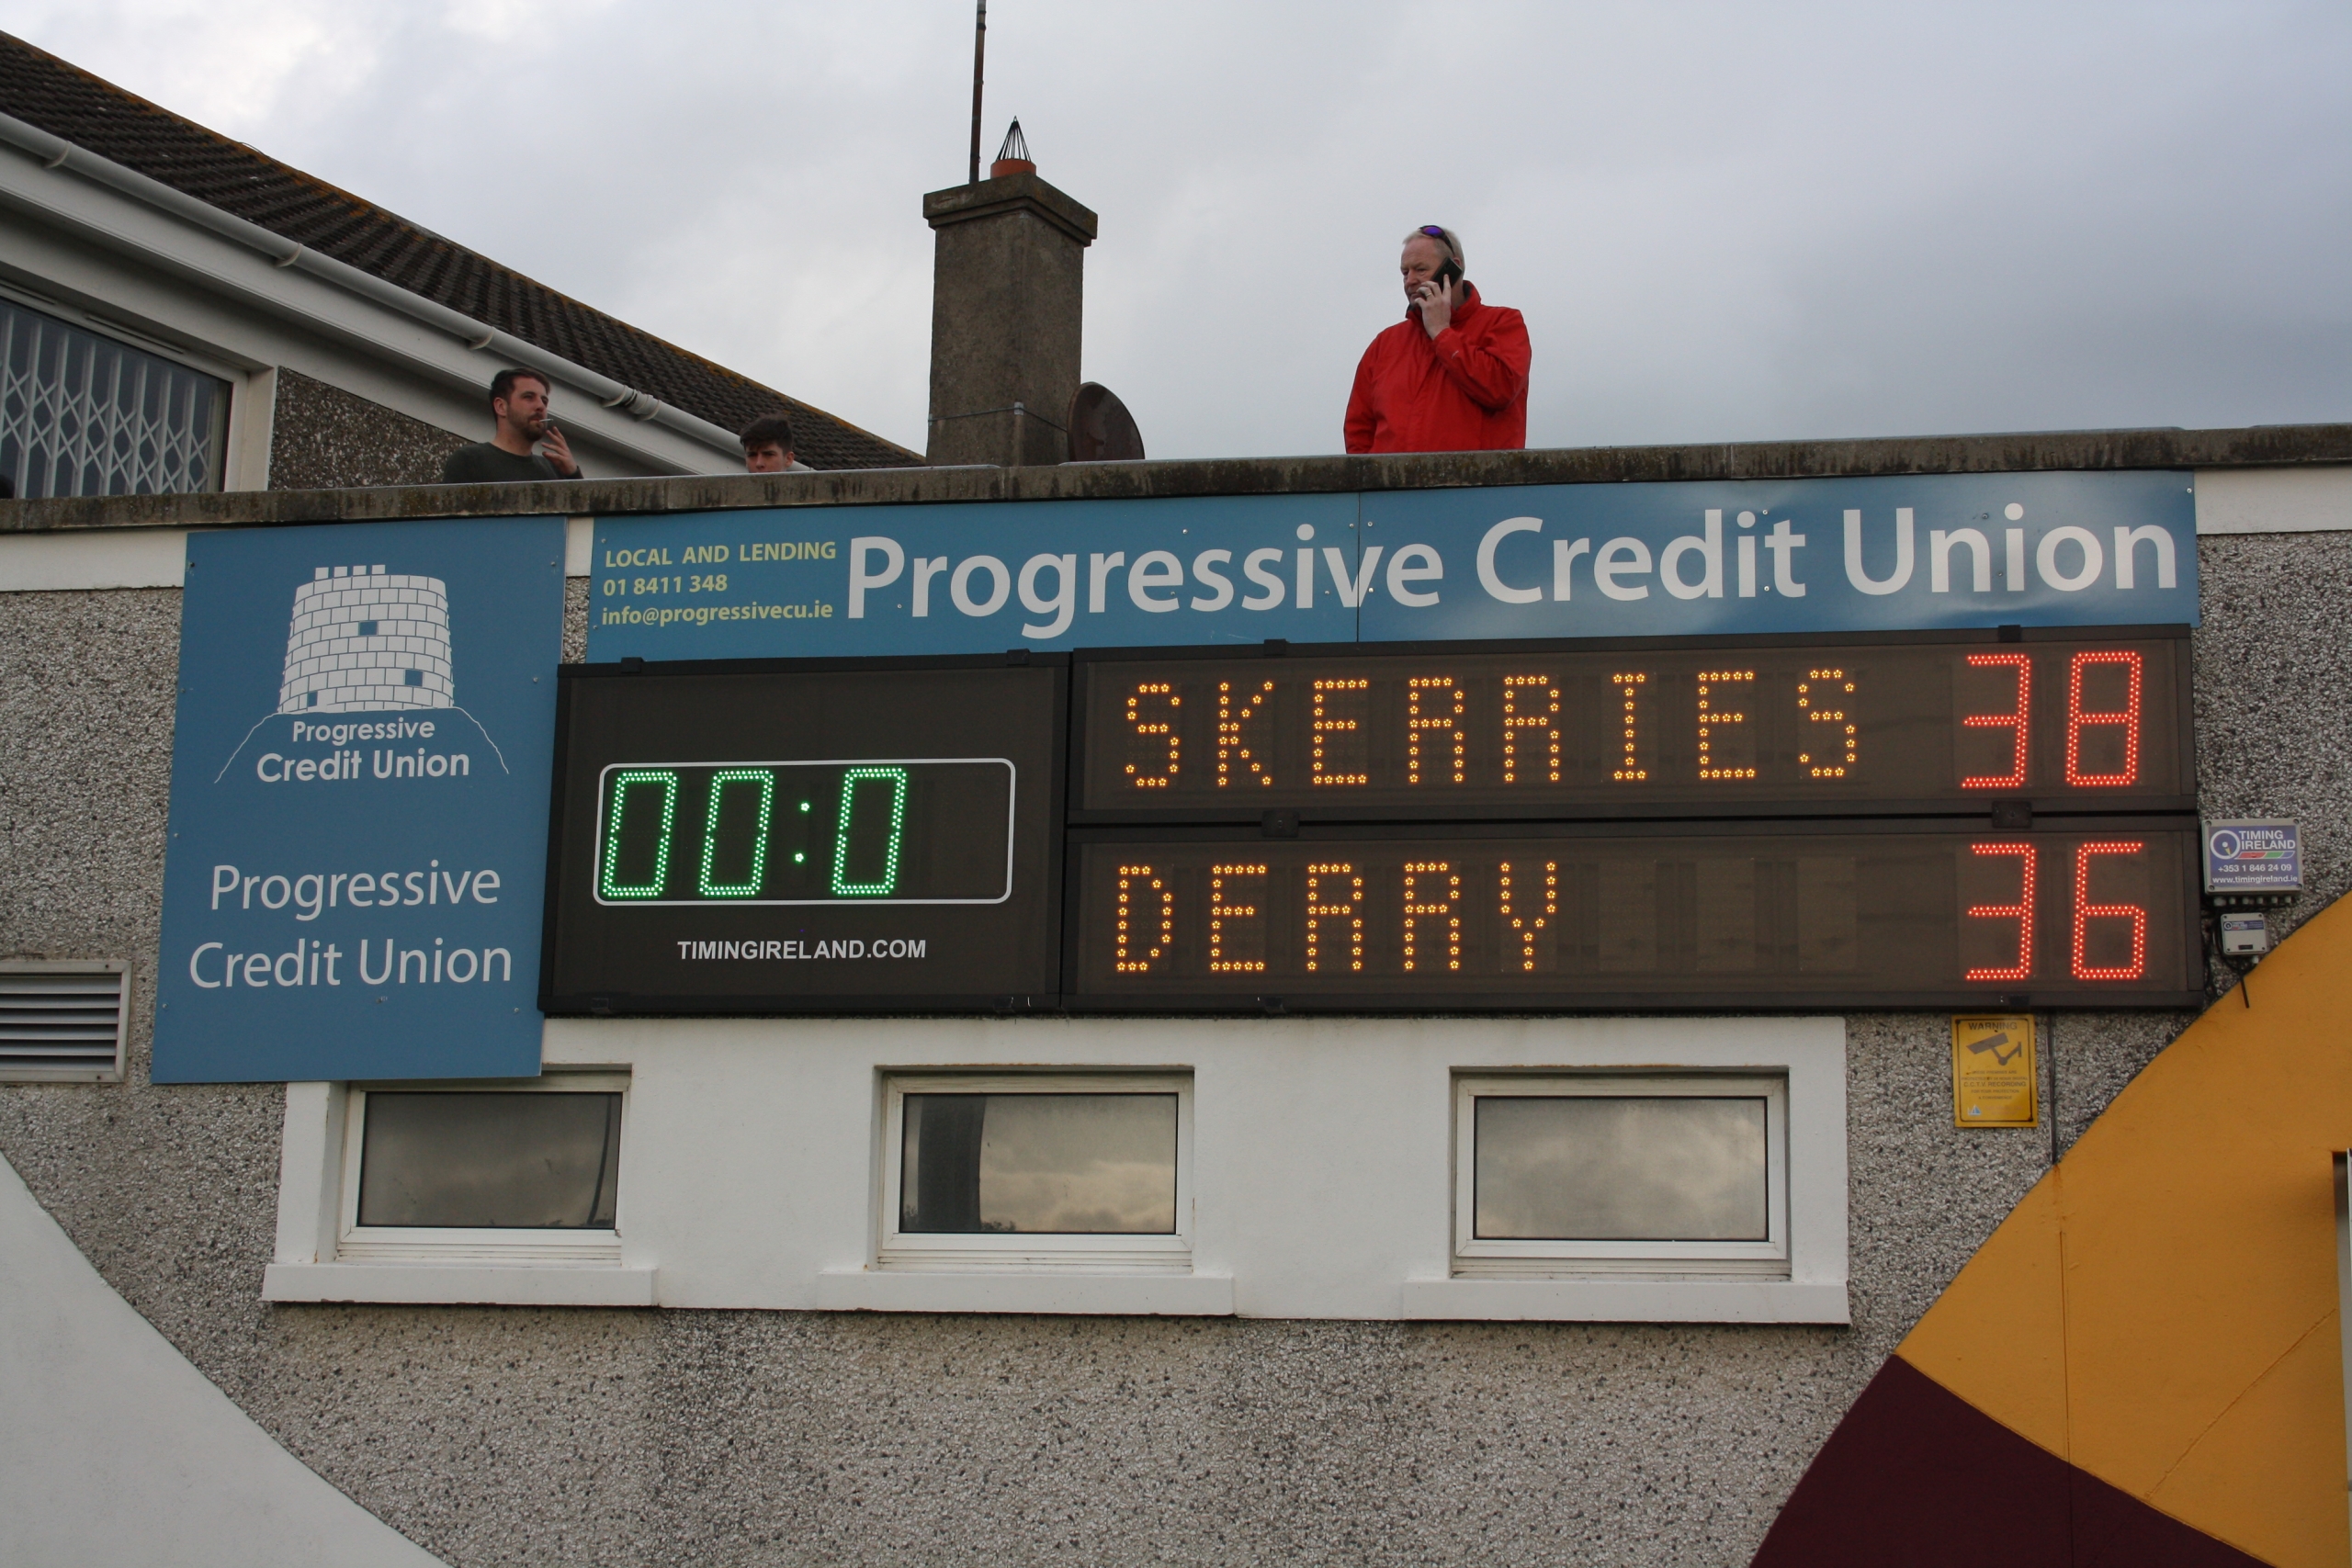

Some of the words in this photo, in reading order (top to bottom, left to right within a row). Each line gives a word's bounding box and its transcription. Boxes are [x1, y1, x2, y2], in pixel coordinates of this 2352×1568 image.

[605, 548, 673, 568] LOCAL
[682, 545, 729, 564] AND
[740, 541, 837, 562] LENDING
[848, 524, 1443, 640] Progressive
[1476, 509, 1806, 604] Credit
[1843, 502, 2177, 596] Union
[603, 579, 627, 596] 01
[633, 576, 682, 595] 8411
[689, 574, 728, 592] 348
[602, 600, 833, 627] info@progressivecu.ie
[292, 717, 435, 746] Progressive
[1960, 650, 2143, 789] 38
[257, 750, 363, 783] Credit
[373, 747, 469, 779] Union
[2238, 830, 2283, 840] TIMING
[2242, 840, 2296, 850] IRELAND
[2212, 875, 2298, 884] www.timingireland.ie
[2218, 864, 2239, 873] +353
[2249, 863, 2266, 872] 846
[2267, 863, 2278, 872] 24
[2280, 863, 2292, 872] 09
[211, 860, 501, 920] Progressive
[1115, 861, 1557, 974] DERRY
[1965, 841, 2146, 980] 36
[190, 938, 343, 988] Credit
[359, 937, 513, 986] Union
[677, 939, 927, 961] TIMINGIRELAND.COM
[1968, 1021, 2018, 1031] WARNING
